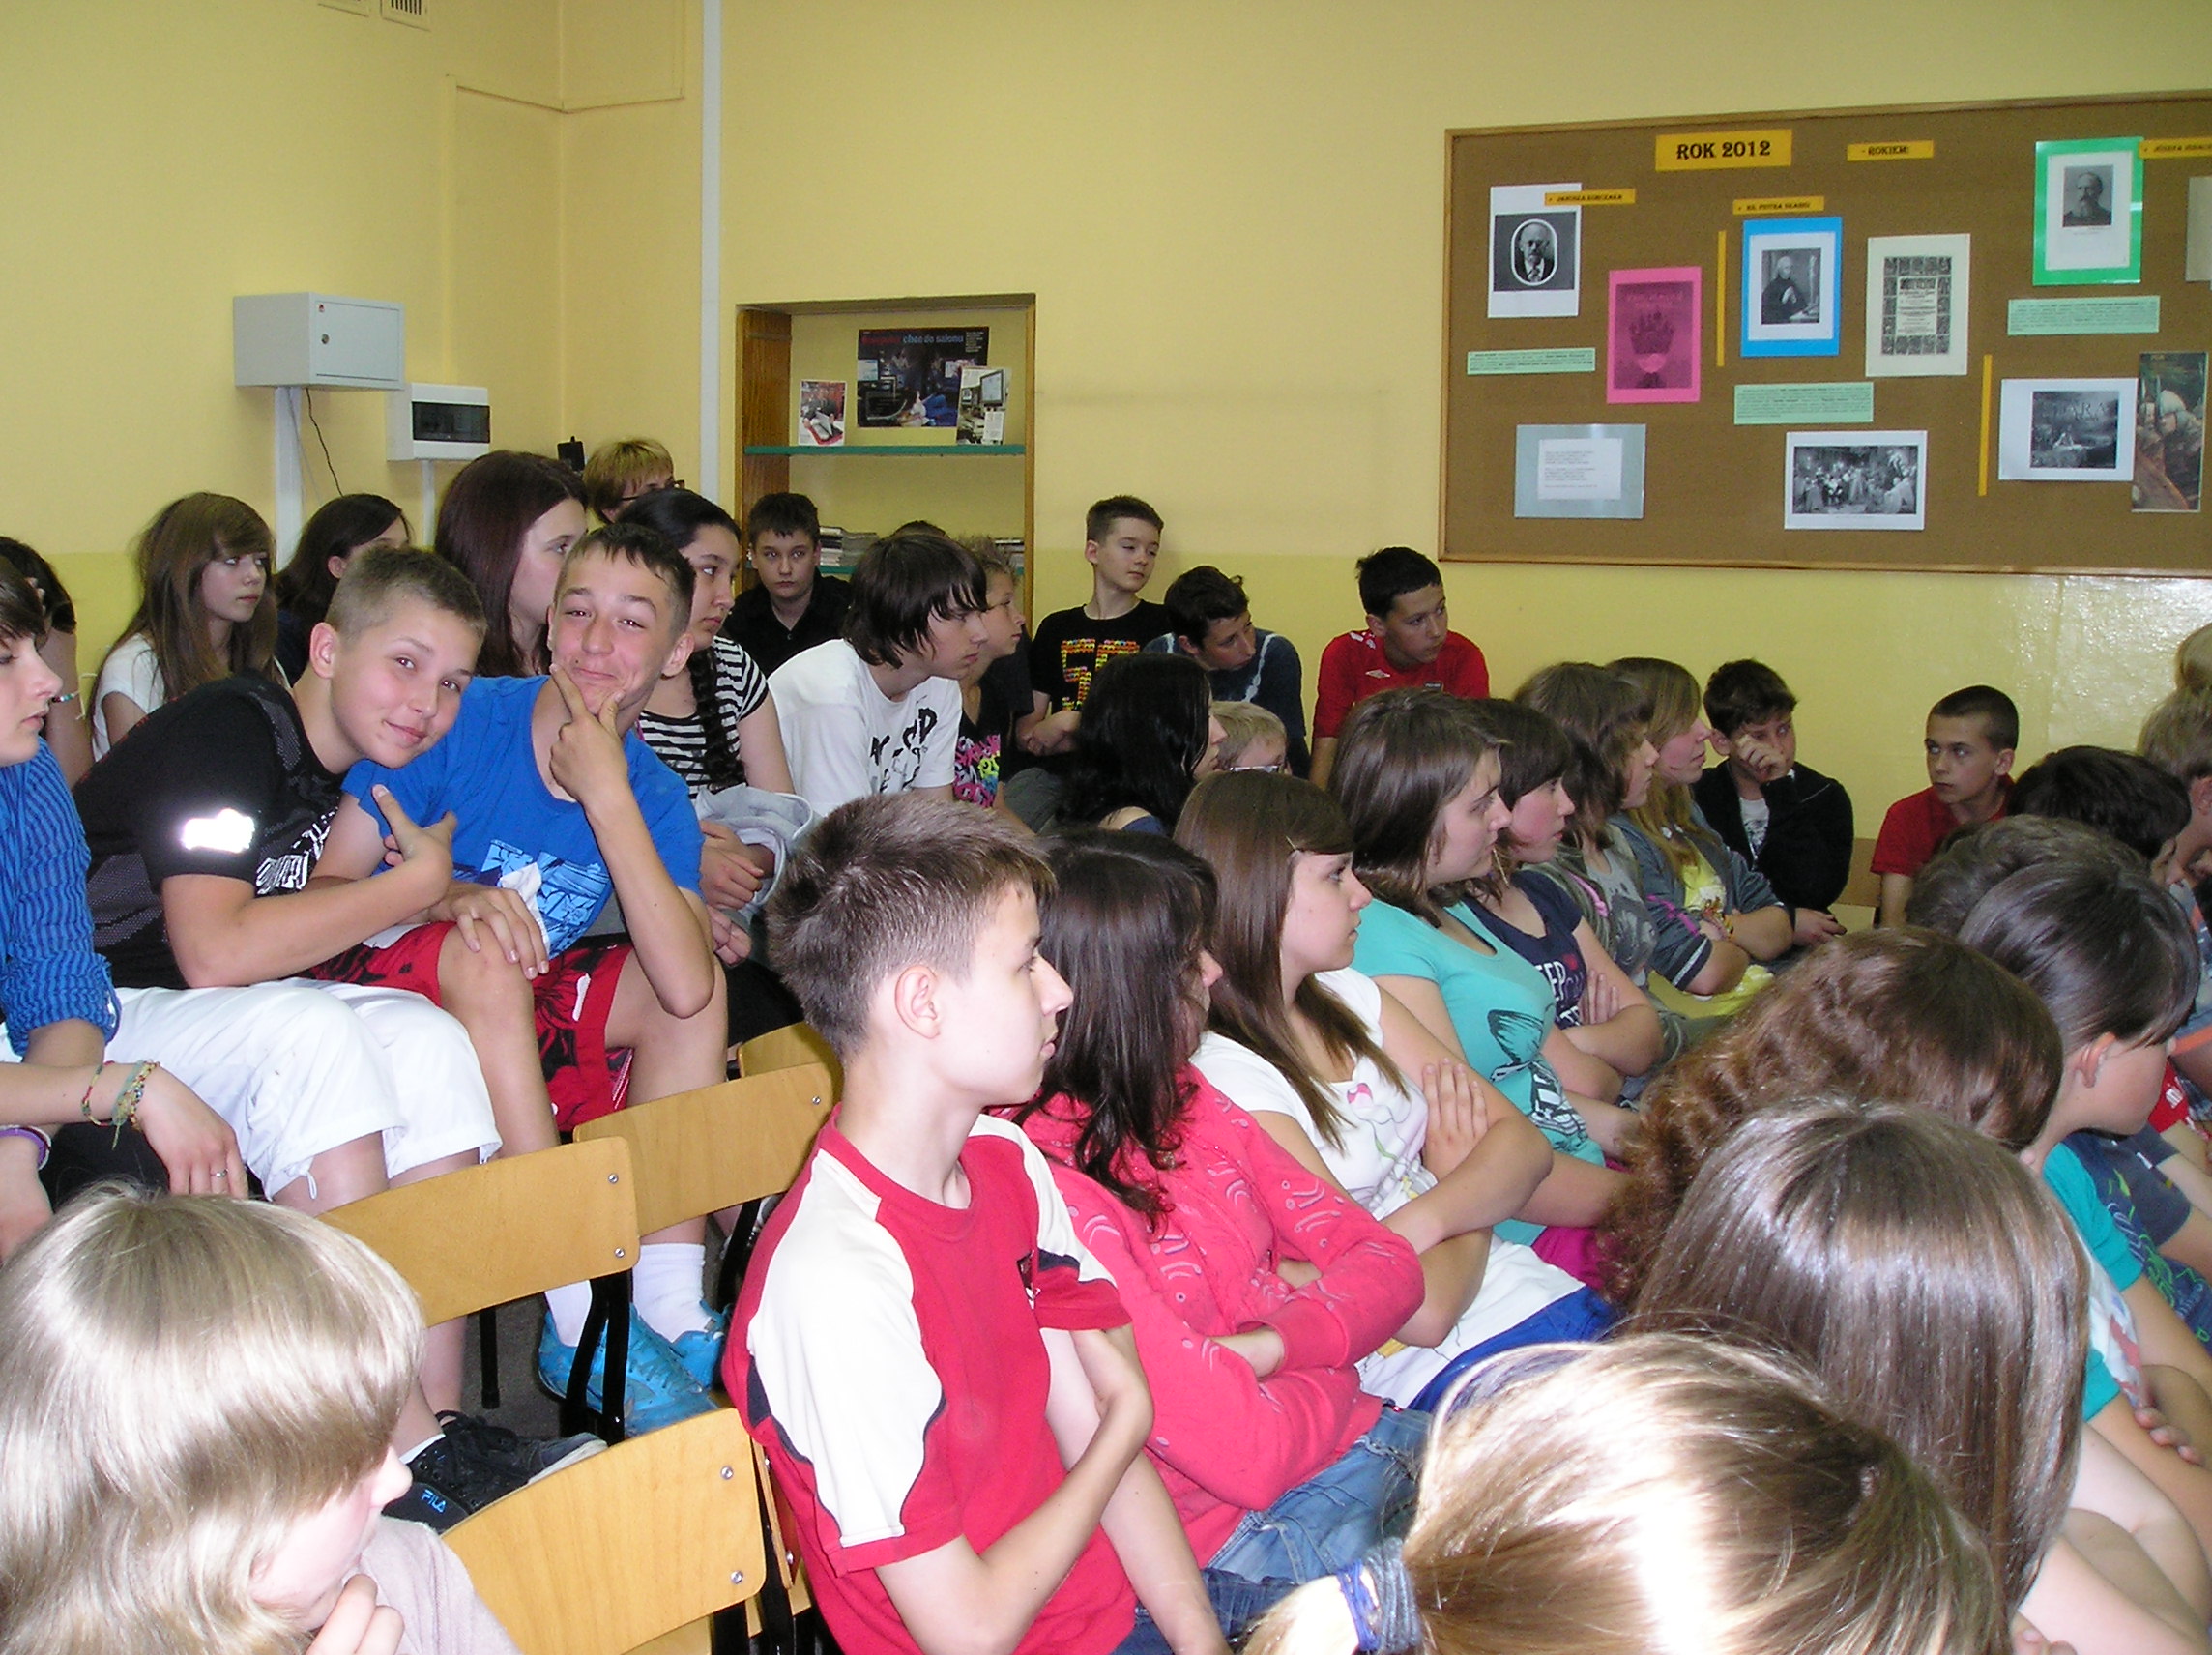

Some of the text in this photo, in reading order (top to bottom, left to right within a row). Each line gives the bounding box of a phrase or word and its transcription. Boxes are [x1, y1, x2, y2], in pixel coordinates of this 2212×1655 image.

[1676, 140, 1770, 160] ROK 2012
[422, 1489, 446, 1513] FILA
